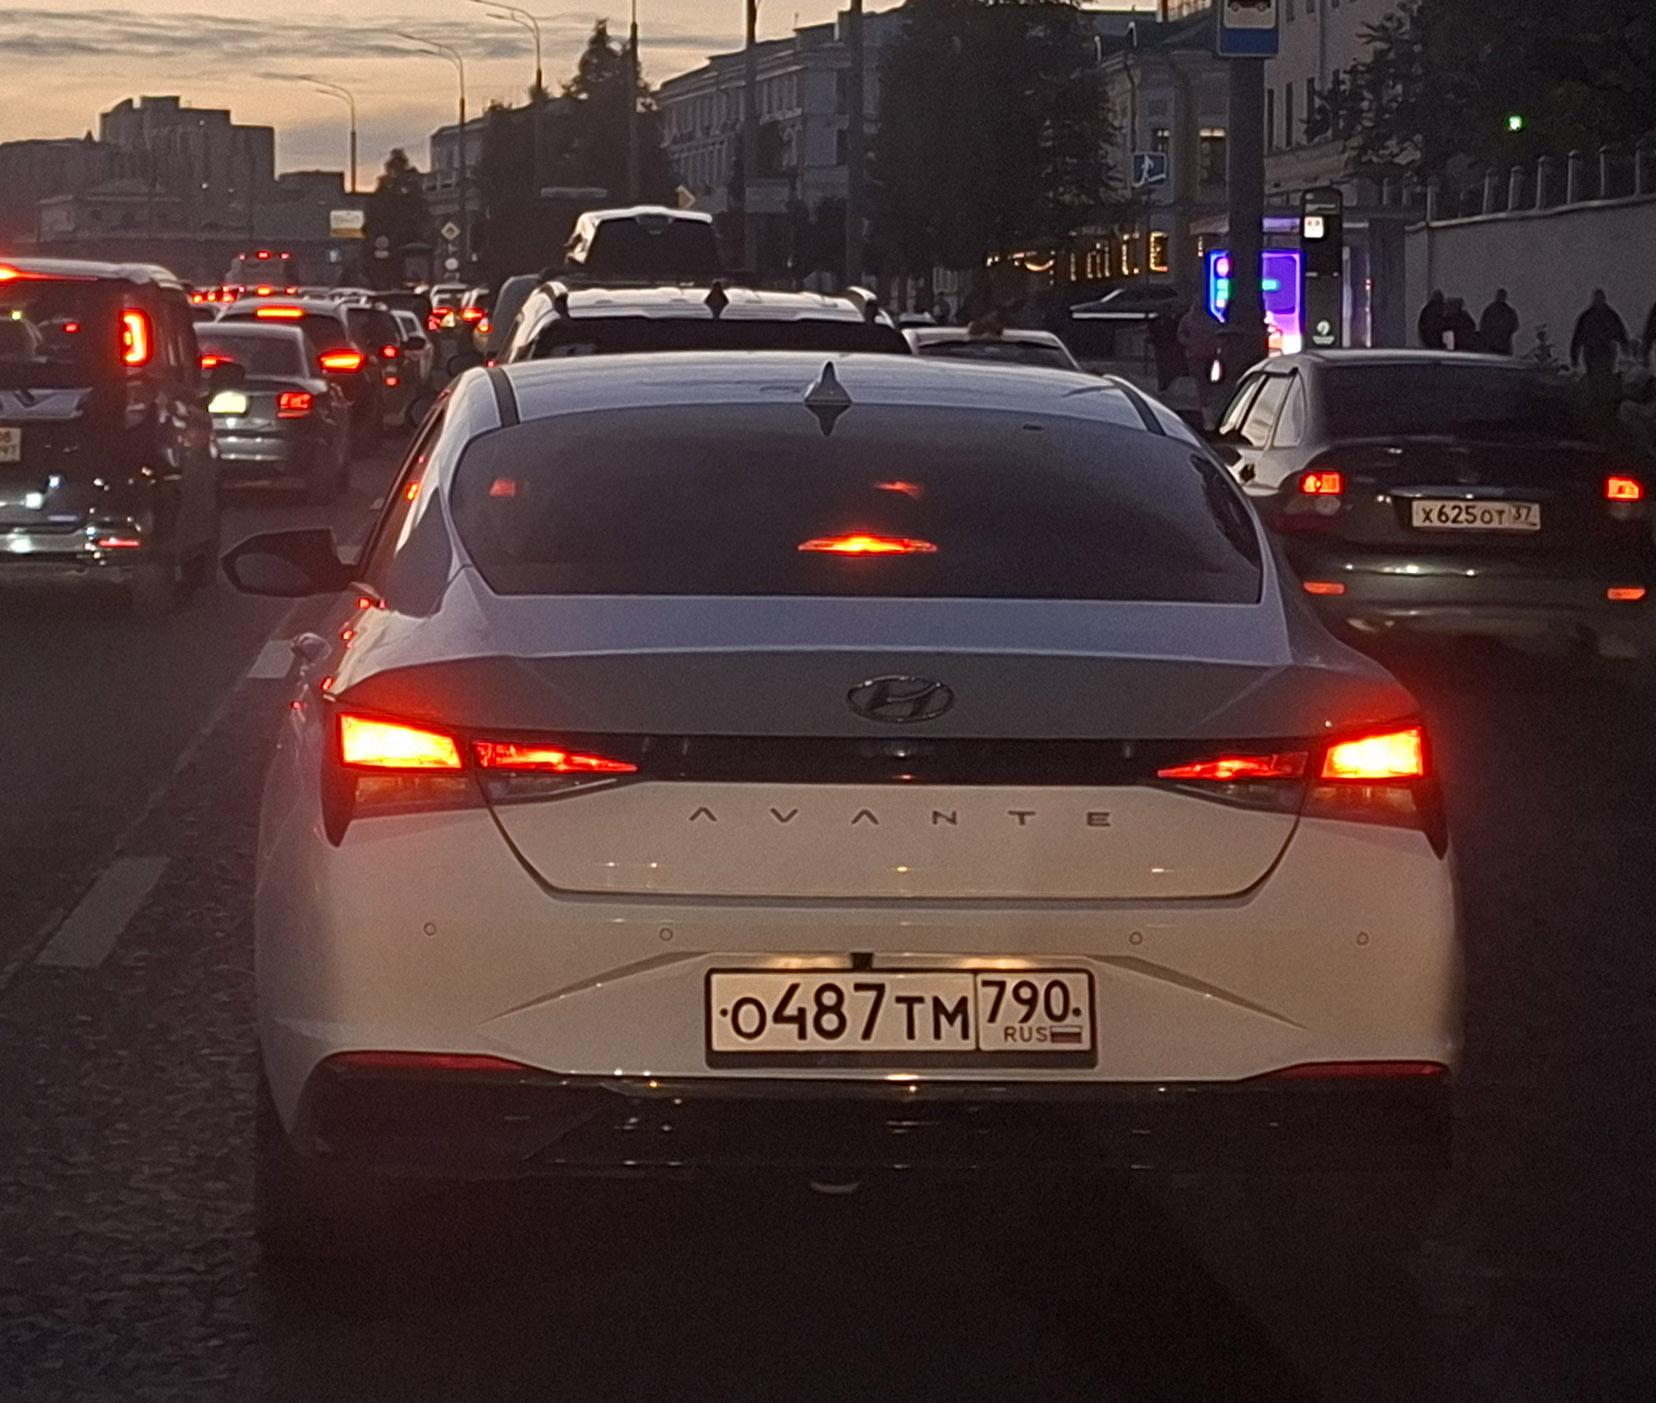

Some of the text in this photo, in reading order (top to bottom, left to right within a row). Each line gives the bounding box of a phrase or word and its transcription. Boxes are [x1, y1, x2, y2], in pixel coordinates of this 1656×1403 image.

[688, 806, 1111, 827] AVANTE
[731, 979, 1070, 1041] О487ТМ 790
[1004, 1026, 1048, 1042] RUS
